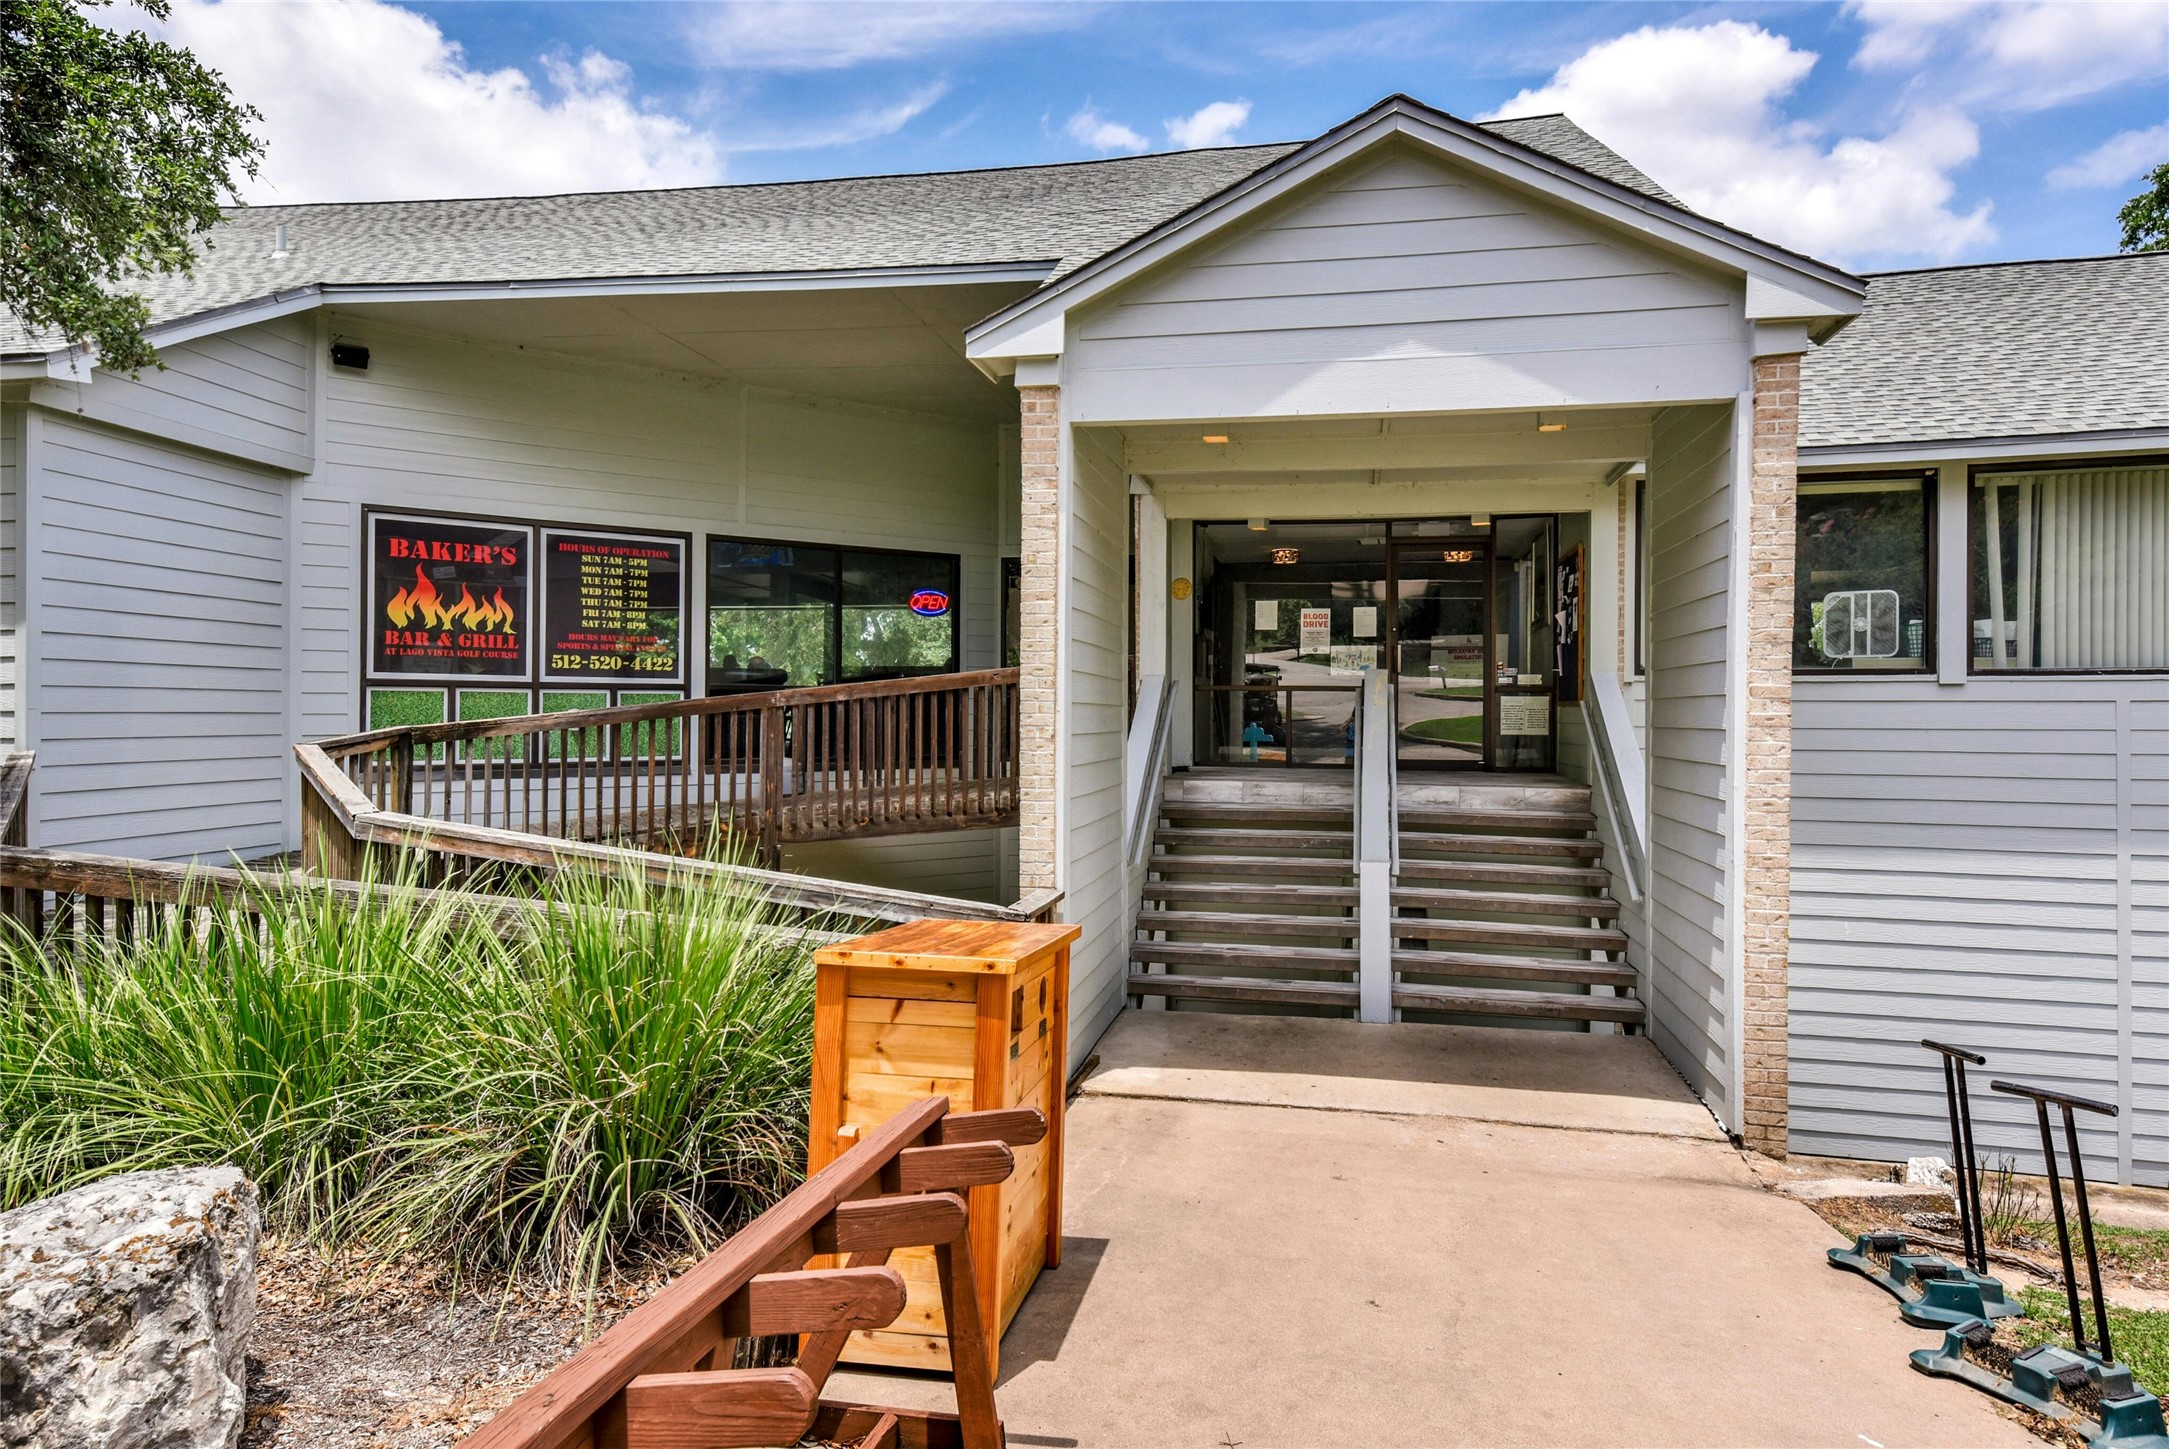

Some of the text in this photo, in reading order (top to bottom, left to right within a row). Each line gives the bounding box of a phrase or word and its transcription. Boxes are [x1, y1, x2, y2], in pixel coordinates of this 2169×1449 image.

[389, 538, 516, 565] BAKER'S
[559, 543, 670, 559] HOURS OF OPERATION
[581, 555, 601, 563] SUN
[603, 556, 622, 564] 7AM
[628, 558, 648, 566] 5PM
[604, 567, 623, 576] 7AM
[630, 569, 648, 577] 7PM
[603, 578, 622, 586] 7AM
[581, 587, 601, 595] WED
[603, 588, 622, 597] 7AM
[629, 590, 648, 598] 7PM
[580, 598, 601, 606] THU
[603, 599, 622, 607] 7AM
[911, 595, 948, 609] OPEN
[583, 609, 599, 617] FRI
[601, 610, 620, 618] 7AM
[582, 620, 600, 628] SAT
[602, 620, 620, 629] 7AM
[384, 630, 519, 649] BAR & GRILL
[600, 634, 617, 642] MAY
[557, 642, 591, 650] SPORTS
[427, 649, 454, 657] VISTA
[552, 654, 674, 671] 512-520-4422
